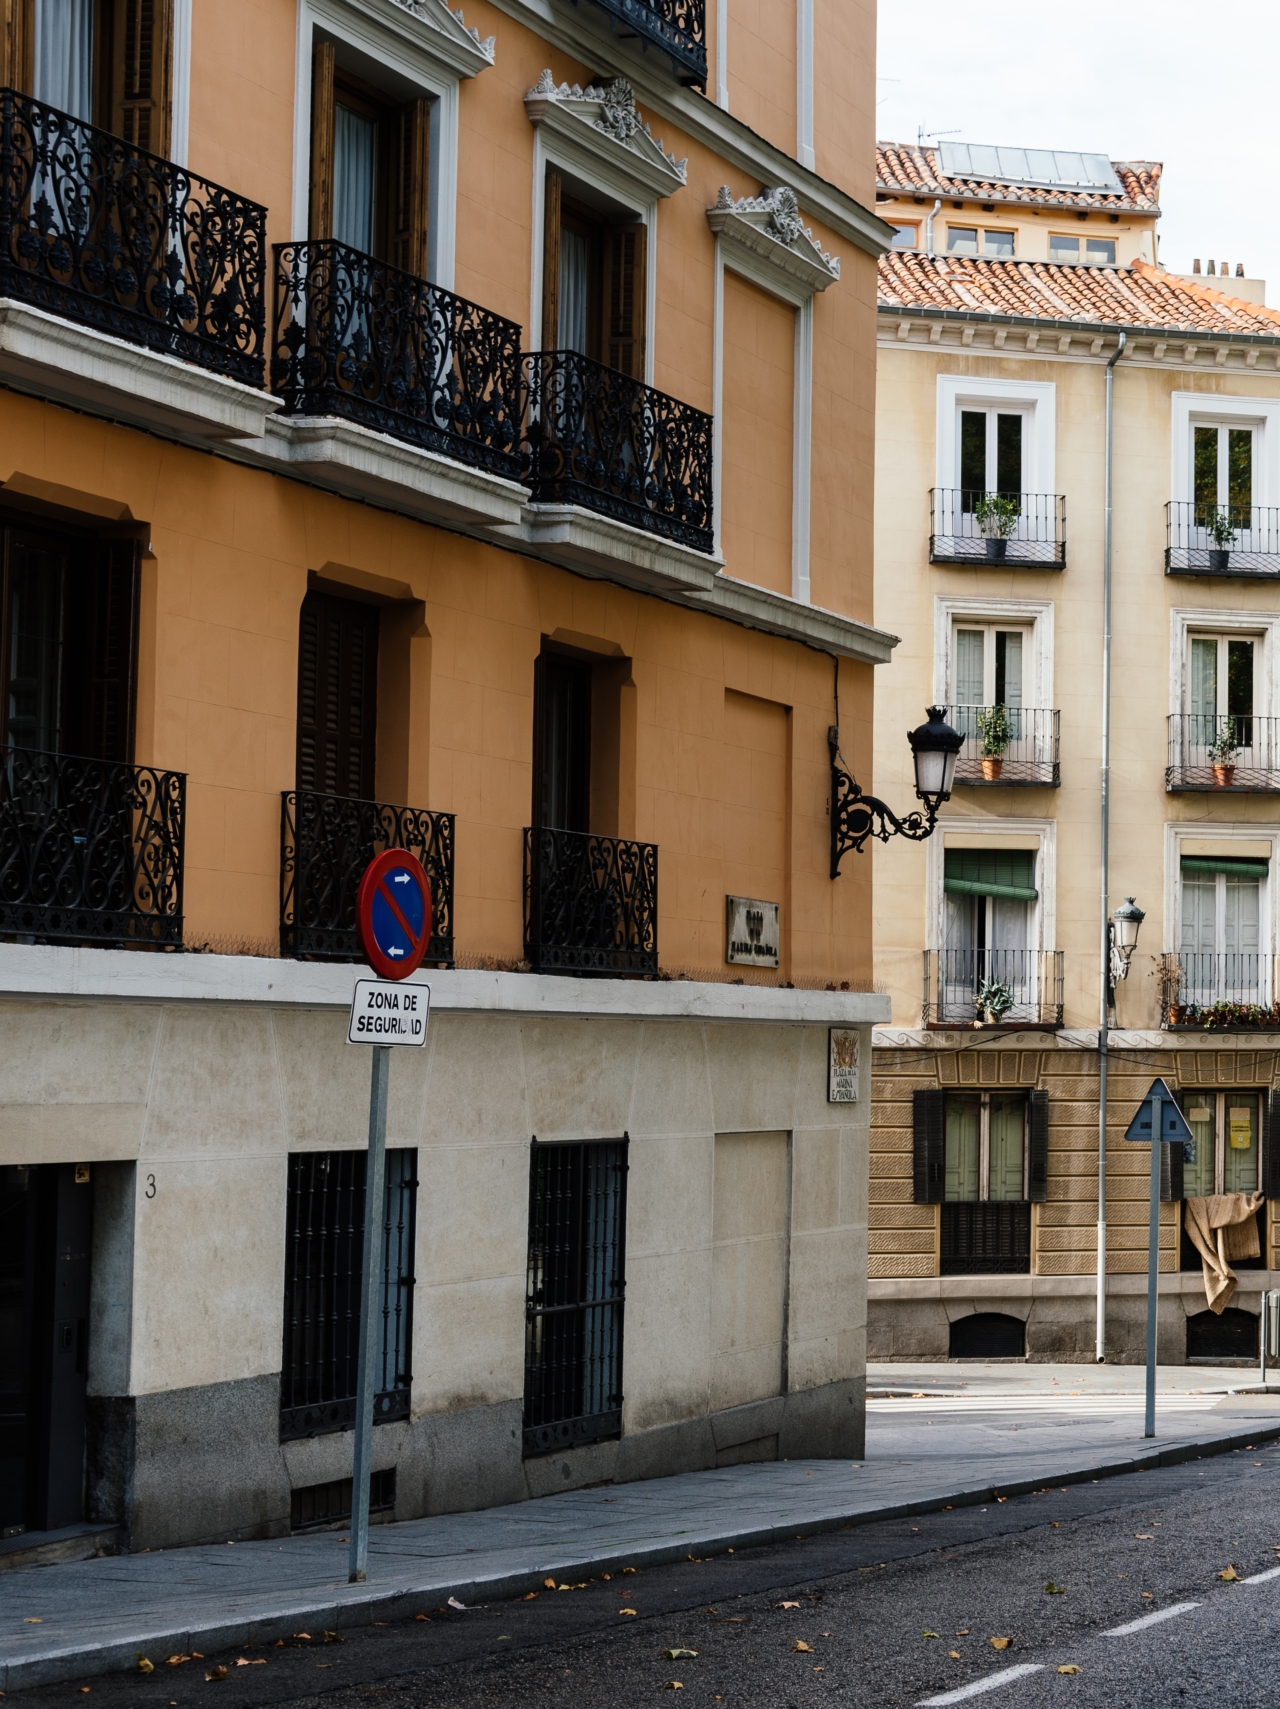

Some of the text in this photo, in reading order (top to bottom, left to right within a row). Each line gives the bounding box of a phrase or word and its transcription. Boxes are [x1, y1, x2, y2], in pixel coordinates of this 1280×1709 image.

[367, 991, 418, 1011] ZONA DE
[356, 1015, 422, 1036] SEGURID
[833, 1068, 847, 1077] PLAZA
[836, 1078, 853, 1089] MARINA
[832, 1089, 857, 1101] ESPAÑOLA
[145, 1173, 157, 1199] 3
